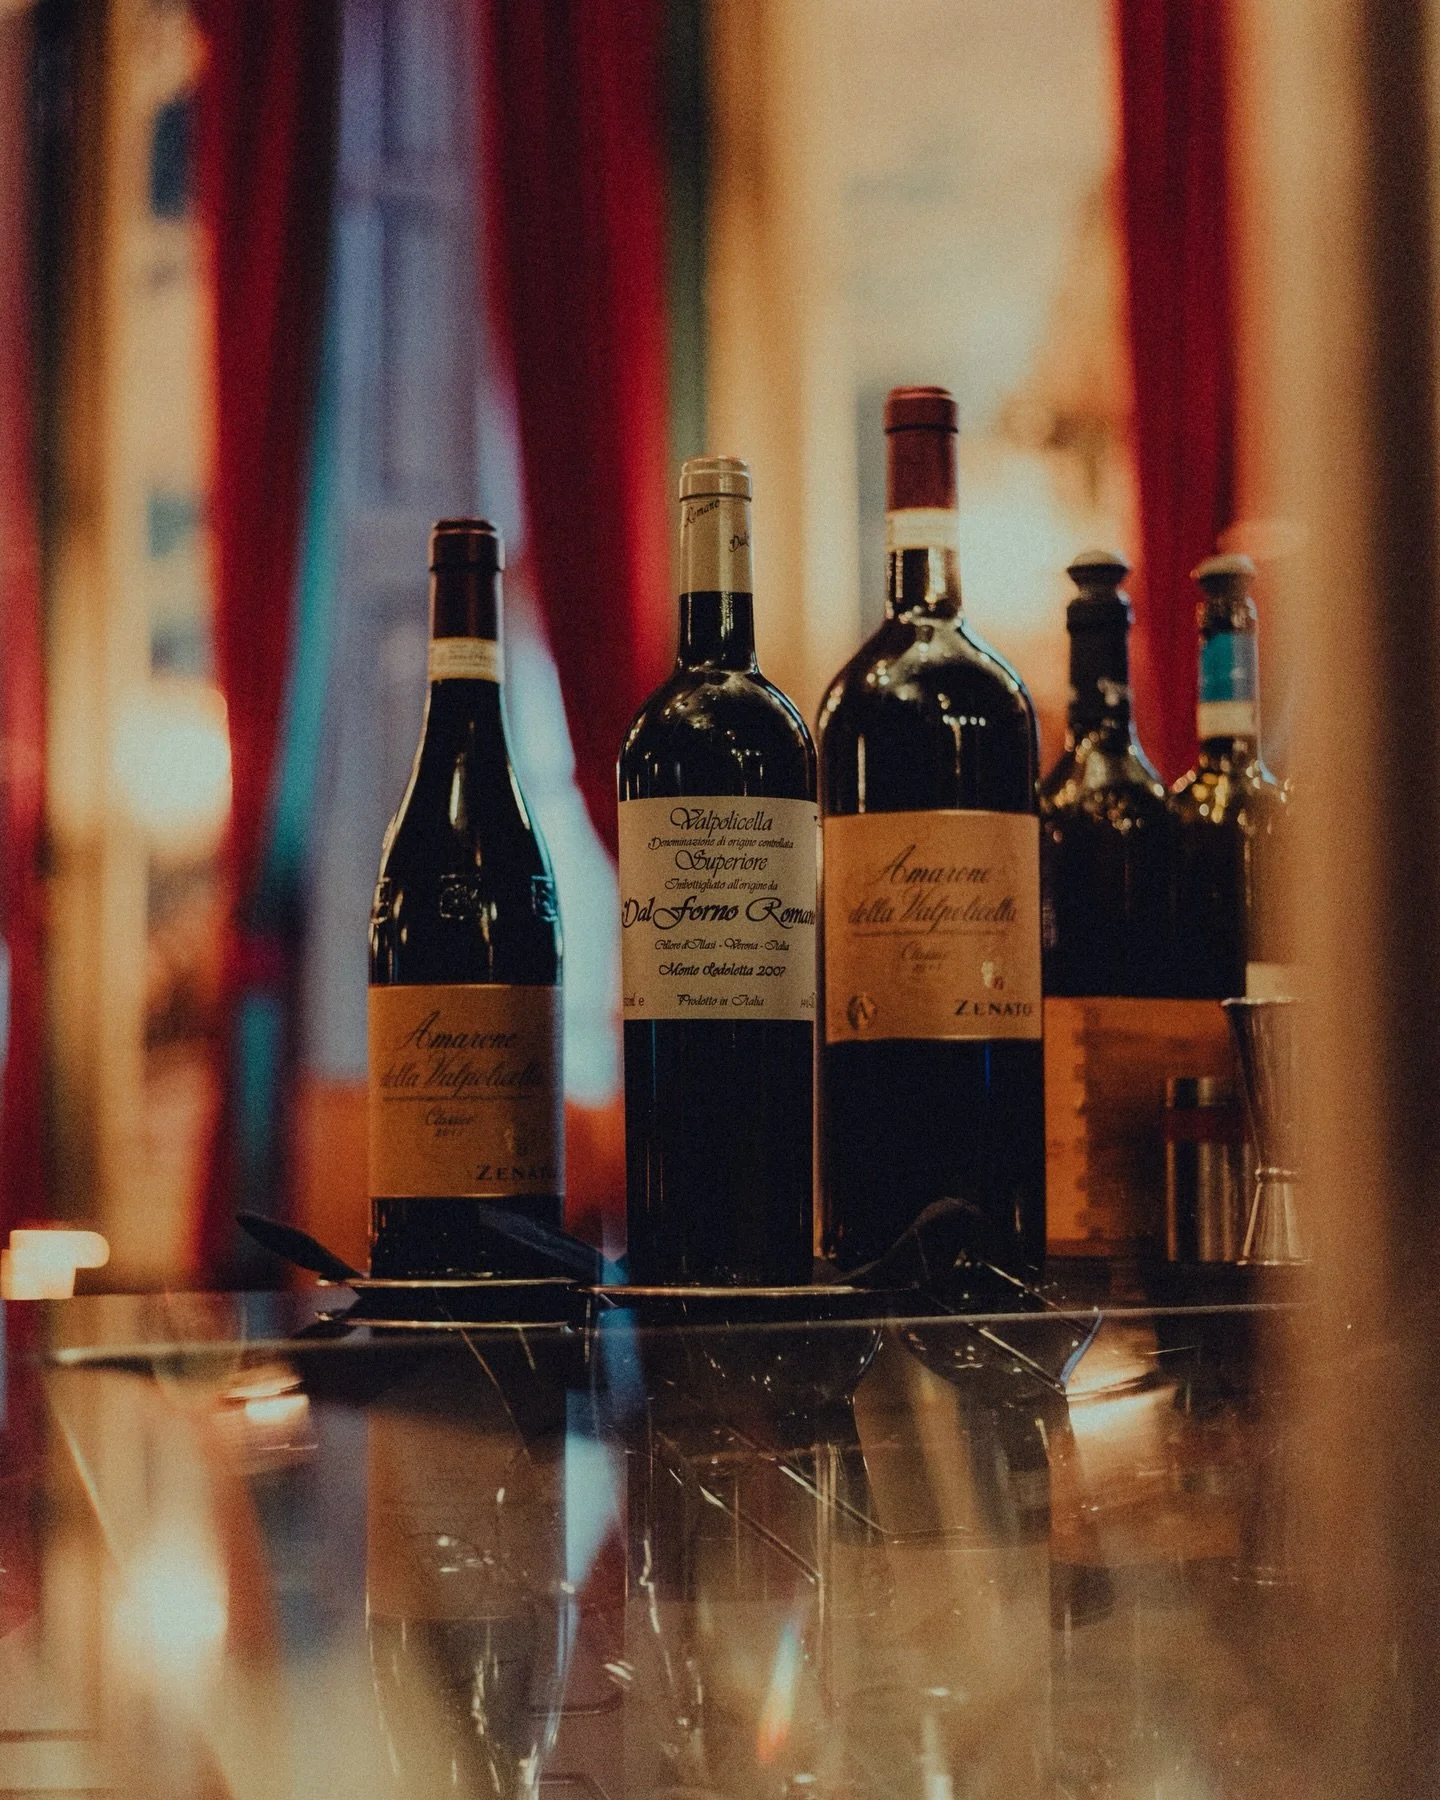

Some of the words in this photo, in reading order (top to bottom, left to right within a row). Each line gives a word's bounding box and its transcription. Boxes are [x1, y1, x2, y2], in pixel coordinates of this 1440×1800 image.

[669, 807, 773, 838] Valpolicella
[648, 836, 715, 850] Denominazione
[716, 836, 726, 847] di
[728, 838, 757, 851] origine
[758, 837, 794, 849] controllata
[674, 849, 768, 878] Superiore
[870, 844, 991, 885] Amarone
[664, 878, 726, 893] Imbottigliato
[727, 878, 768, 893] all'origine
[768, 880, 778, 891] da
[622, 896, 655, 928] Dal
[652, 895, 739, 930] Forno
[849, 896, 896, 924] della
[900, 885, 1017, 935] Valpolicella
[724, 937, 759, 951] Verona
[764, 939, 790, 951] Italia
[658, 961, 700, 976] Monte
[755, 965, 786, 977] 2007
[676, 993, 718, 1007] Prodotto
[719, 995, 729, 1006] in
[731, 993, 764, 1006] Italia
[955, 999, 1033, 1017] ZENATO
[401, 1009, 517, 1050] Amarone
